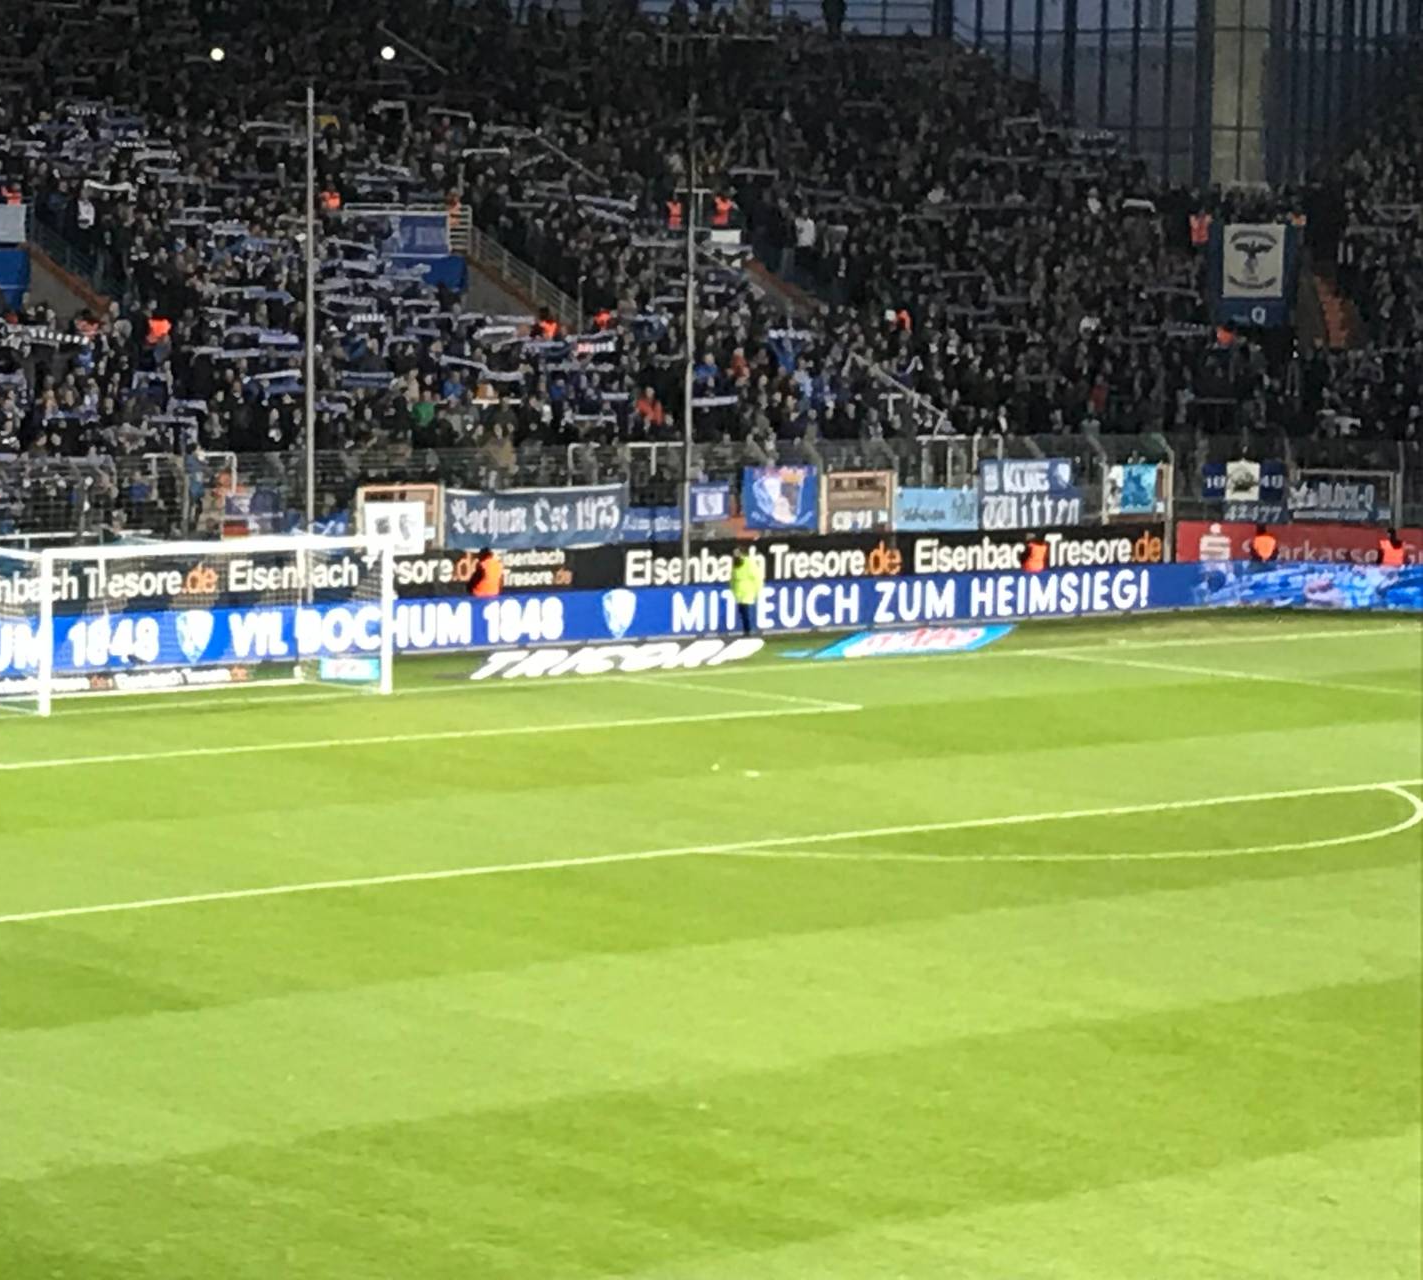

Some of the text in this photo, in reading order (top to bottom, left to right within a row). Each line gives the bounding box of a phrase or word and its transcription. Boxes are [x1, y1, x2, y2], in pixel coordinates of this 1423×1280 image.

[625, 540, 903, 587] Eisenbah Tresore.de
[914, 529, 1162, 574] Eisenbac Tresore.de
[1241, 538, 1380, 563] Sarkasse
[83, 562, 219, 600] Tesore.de
[228, 556, 359, 594] Eisenach
[756, 582, 860, 629] EUCH
[873, 575, 956, 623] ZUM
[970, 567, 1150, 618] HEIMSIEG!
[67, 616, 160, 667] 1848
[228, 595, 564, 659] VfL BOCHUM 1848
[469, 638, 765, 680] TRICORP
